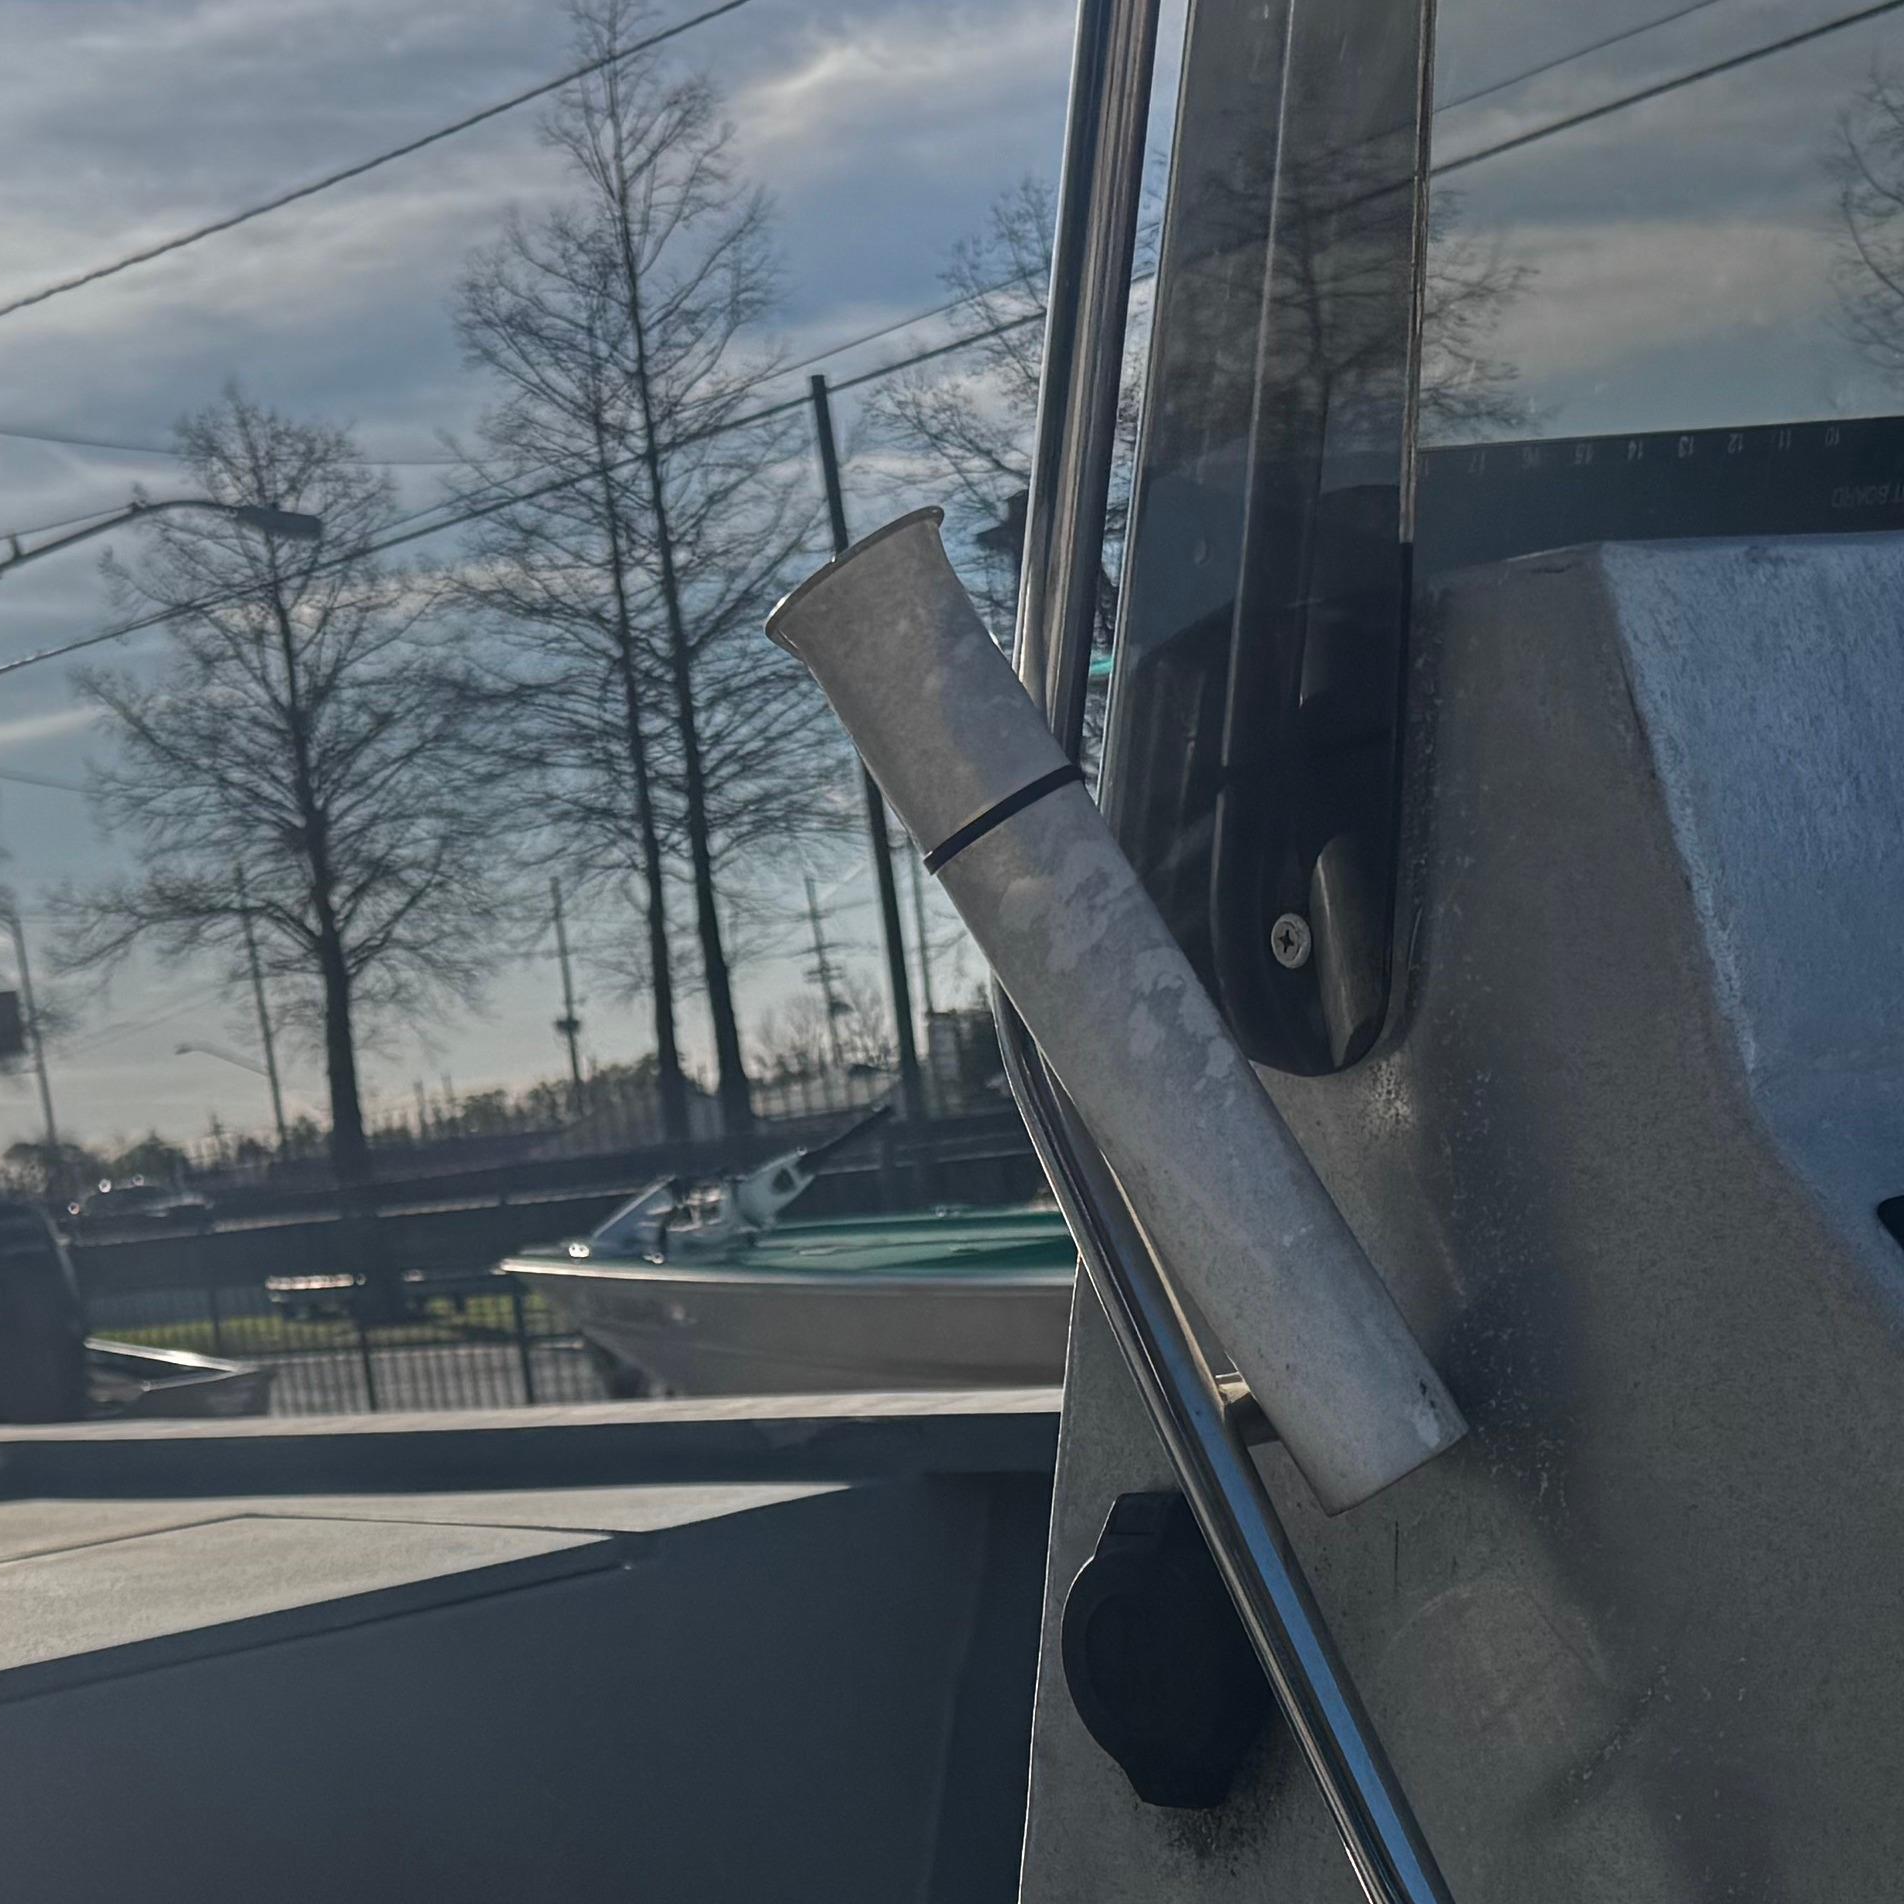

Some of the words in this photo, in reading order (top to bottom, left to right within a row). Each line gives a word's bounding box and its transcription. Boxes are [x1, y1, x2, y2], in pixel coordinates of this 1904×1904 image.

[1678, 436, 1694, 458] 13
[1727, 433, 1744, 454] 12
[1831, 483, 1889, 509] BOARD
